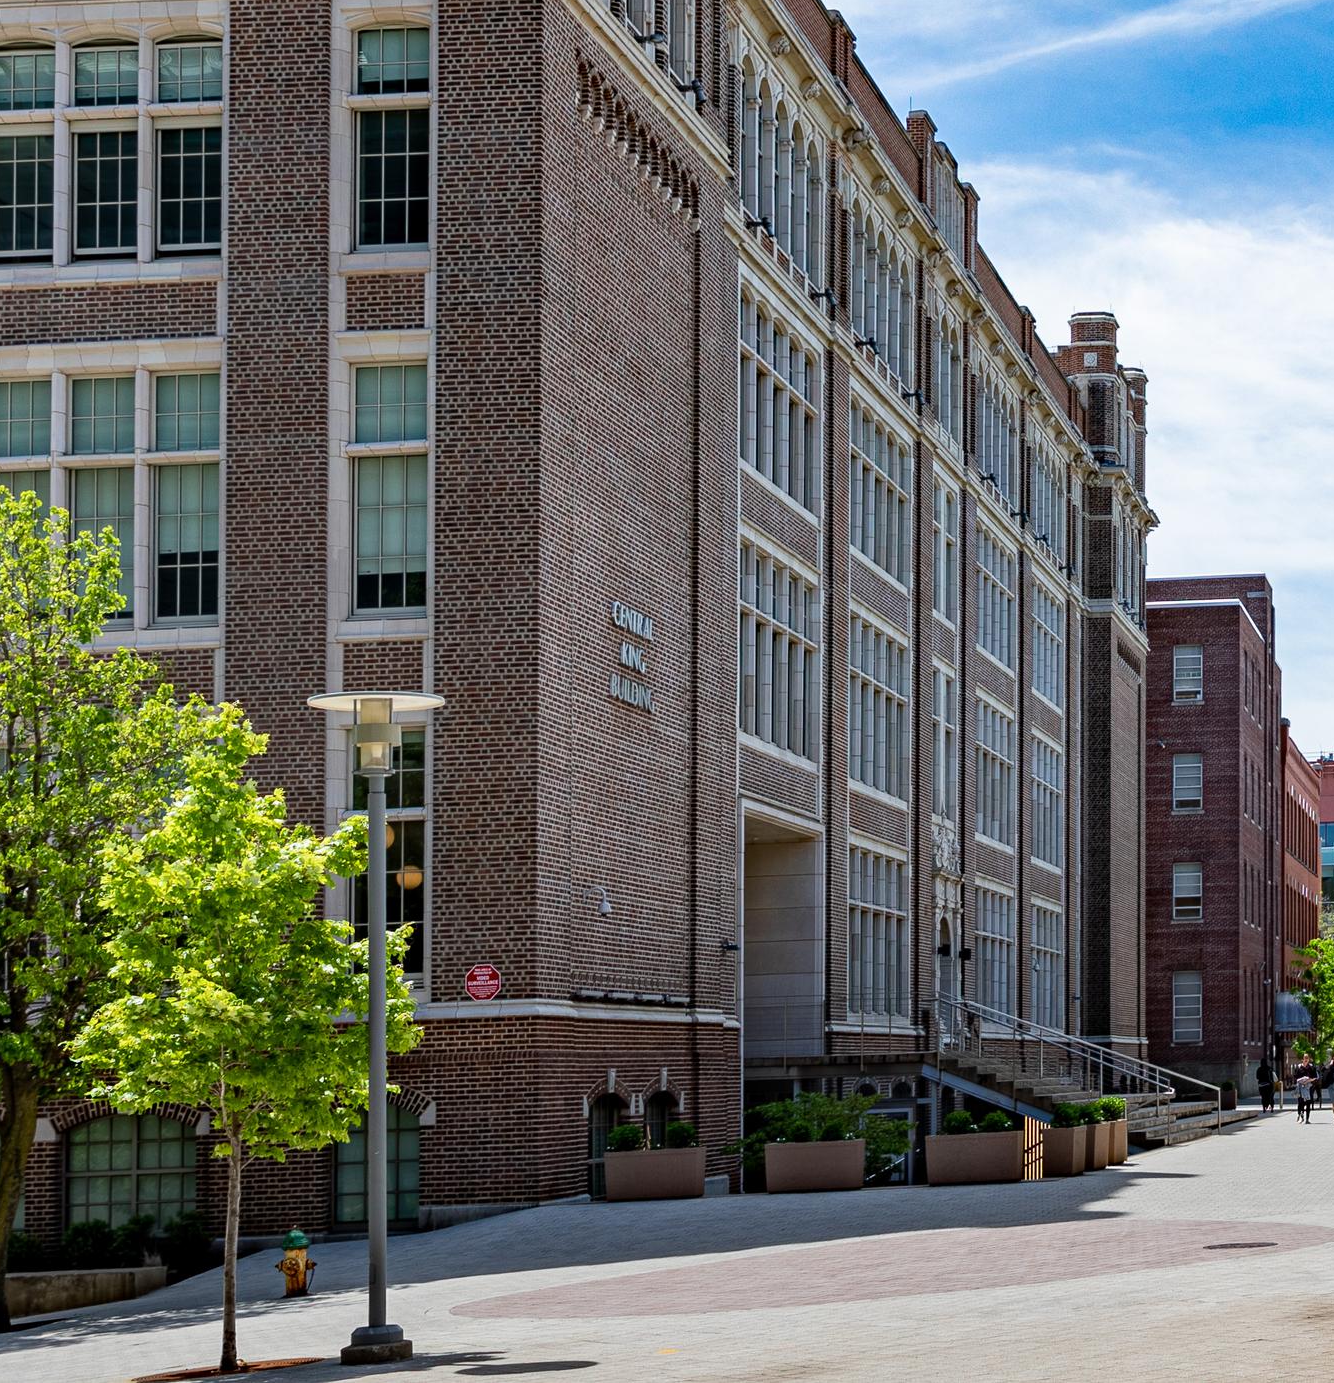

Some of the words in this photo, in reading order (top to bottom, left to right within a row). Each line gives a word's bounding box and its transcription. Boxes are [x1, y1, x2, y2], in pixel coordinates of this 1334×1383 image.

[611, 601, 653, 641] CENTRAL
[620, 641, 646, 673] KING
[610, 673, 656, 714] BUILDING
